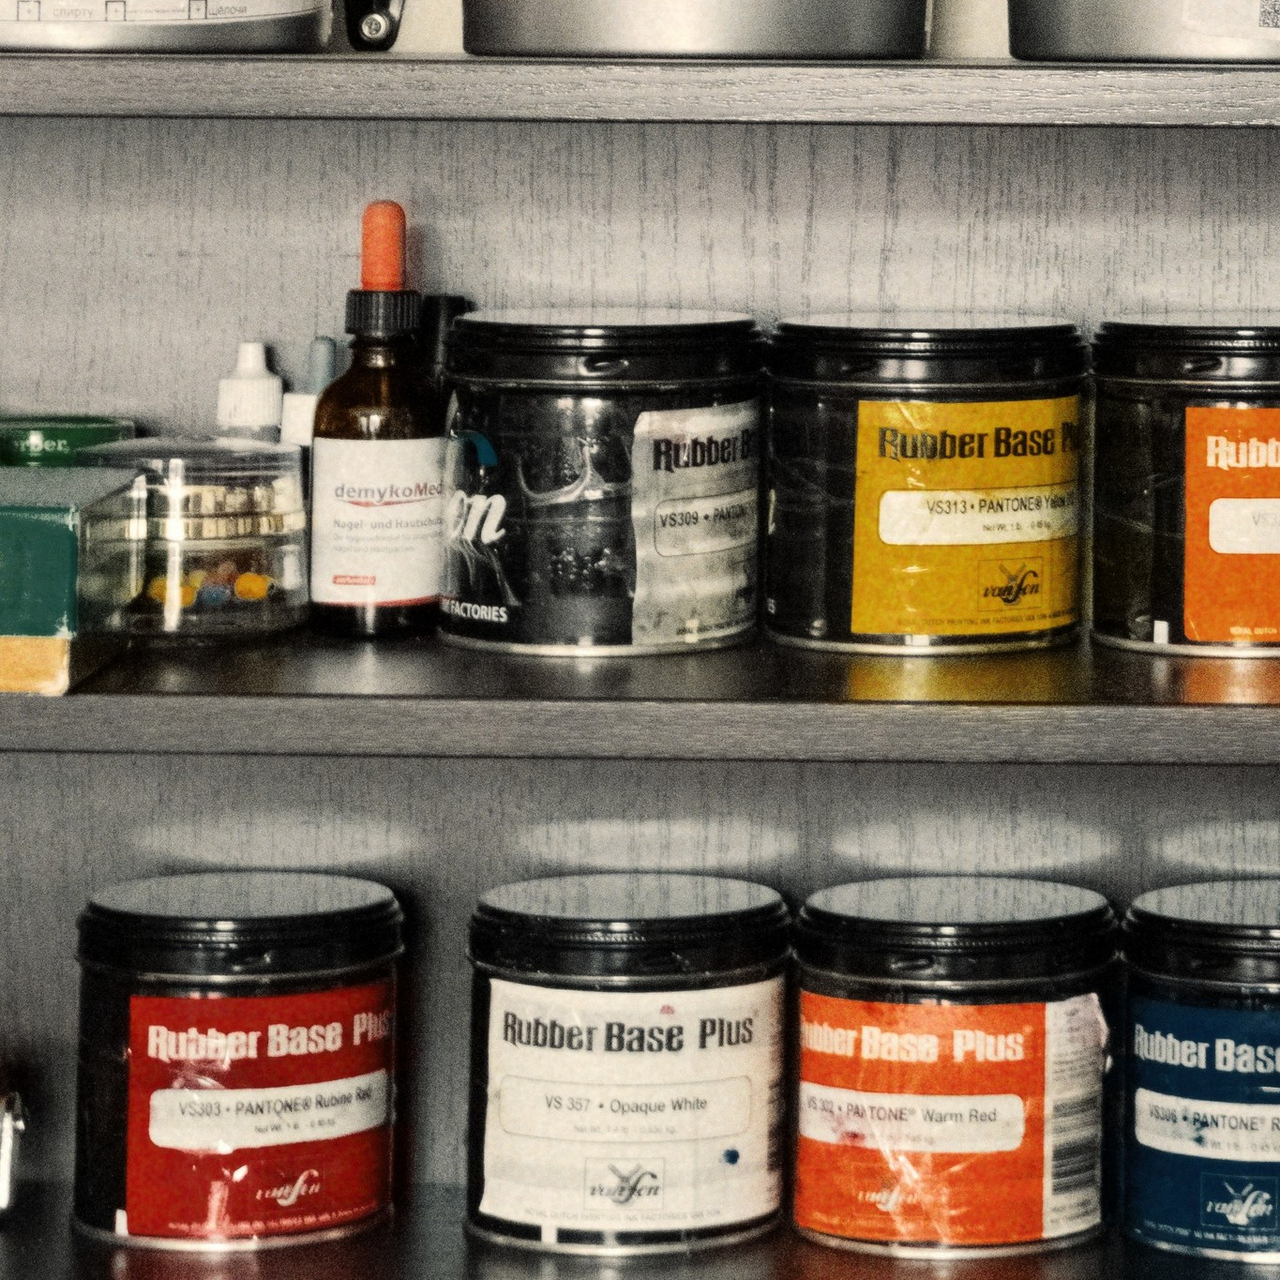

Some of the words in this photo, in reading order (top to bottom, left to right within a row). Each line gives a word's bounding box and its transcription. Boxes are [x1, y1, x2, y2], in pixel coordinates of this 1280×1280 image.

[52, 6, 93, 20] спирту
[994, 428, 1055, 458] Base
[653, 435, 737, 472] Rubber
[927, 500, 968, 515] VS313
[371, 520, 392, 528] und
[660, 512, 699, 528] VS309
[450, 601, 508, 622] FACTORIES
[503, 1011, 597, 1052] Rubber
[605, 1022, 684, 1053] Base
[699, 1016, 753, 1048] Plus
[861, 1026, 939, 1063] Base
[545, 1095, 564, 1109] VS
[567, 1097, 591, 1110] 357
[610, 1099, 665, 1114] Opaque
[671, 1096, 707, 1111] White
[922, 1109, 963, 1123] Warm
[968, 1108, 996, 1121] Red
